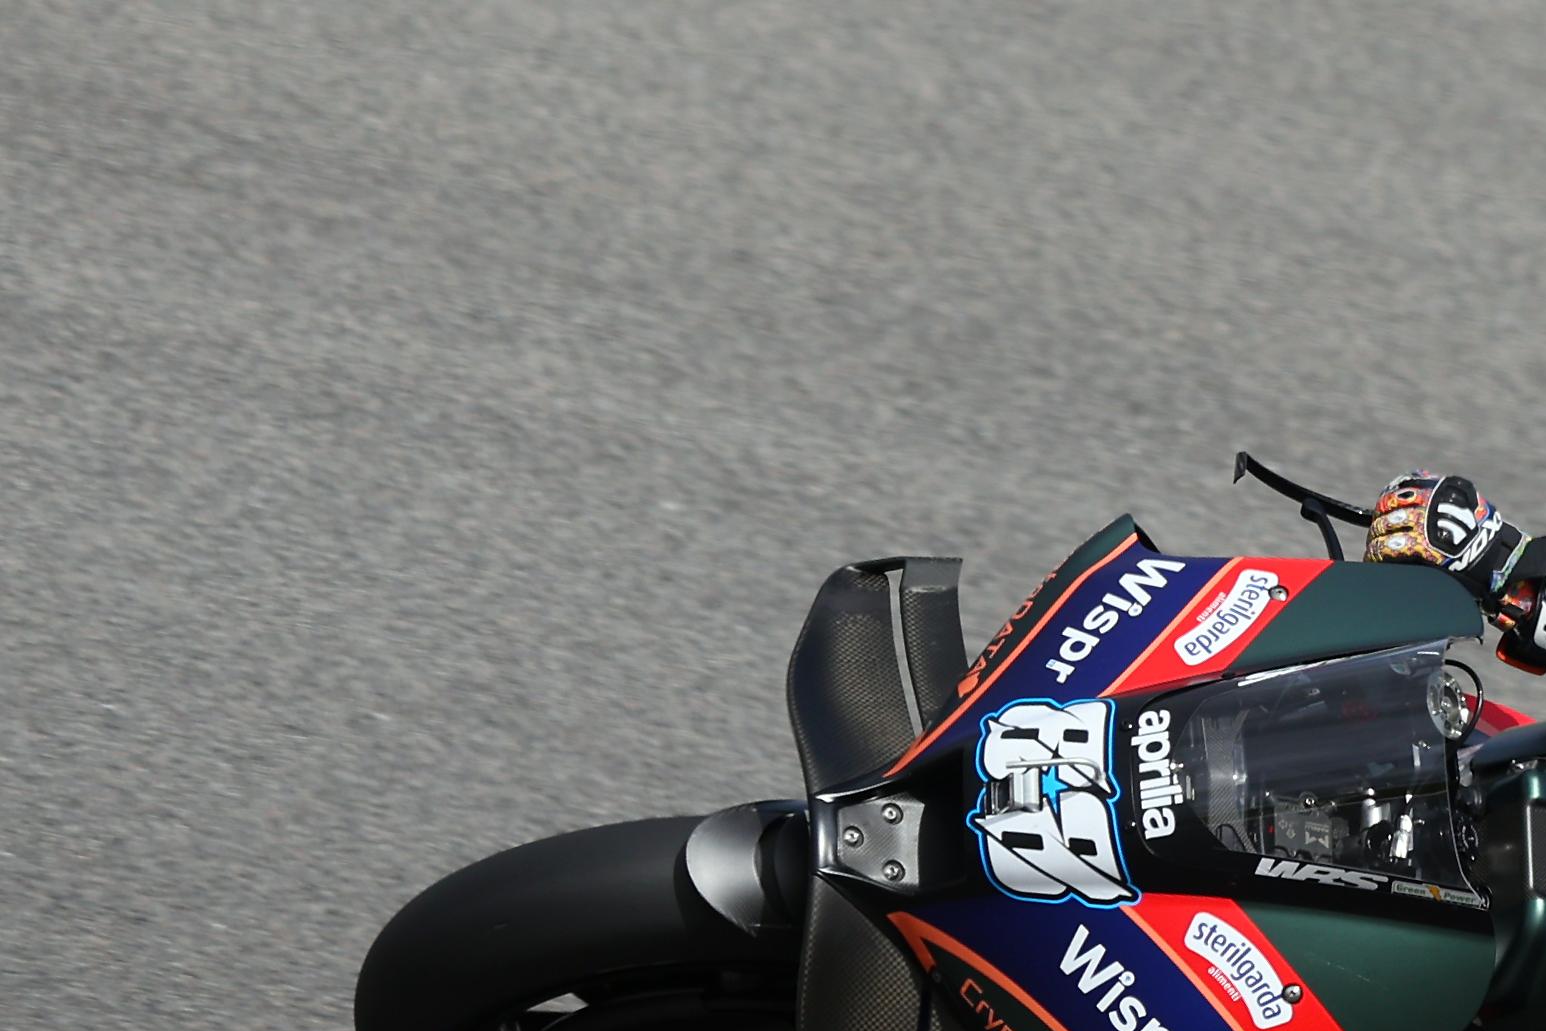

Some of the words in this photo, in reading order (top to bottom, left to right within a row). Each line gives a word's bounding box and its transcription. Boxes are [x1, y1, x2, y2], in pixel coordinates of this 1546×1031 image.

[1046, 558, 1186, 684] Wispr
[1184, 575, 1269, 656] sterilgarda
[1132, 709, 1183, 839] aprilia
[1254, 857, 1389, 891] WRS
[1193, 922, 1282, 1020] sterilgarda
